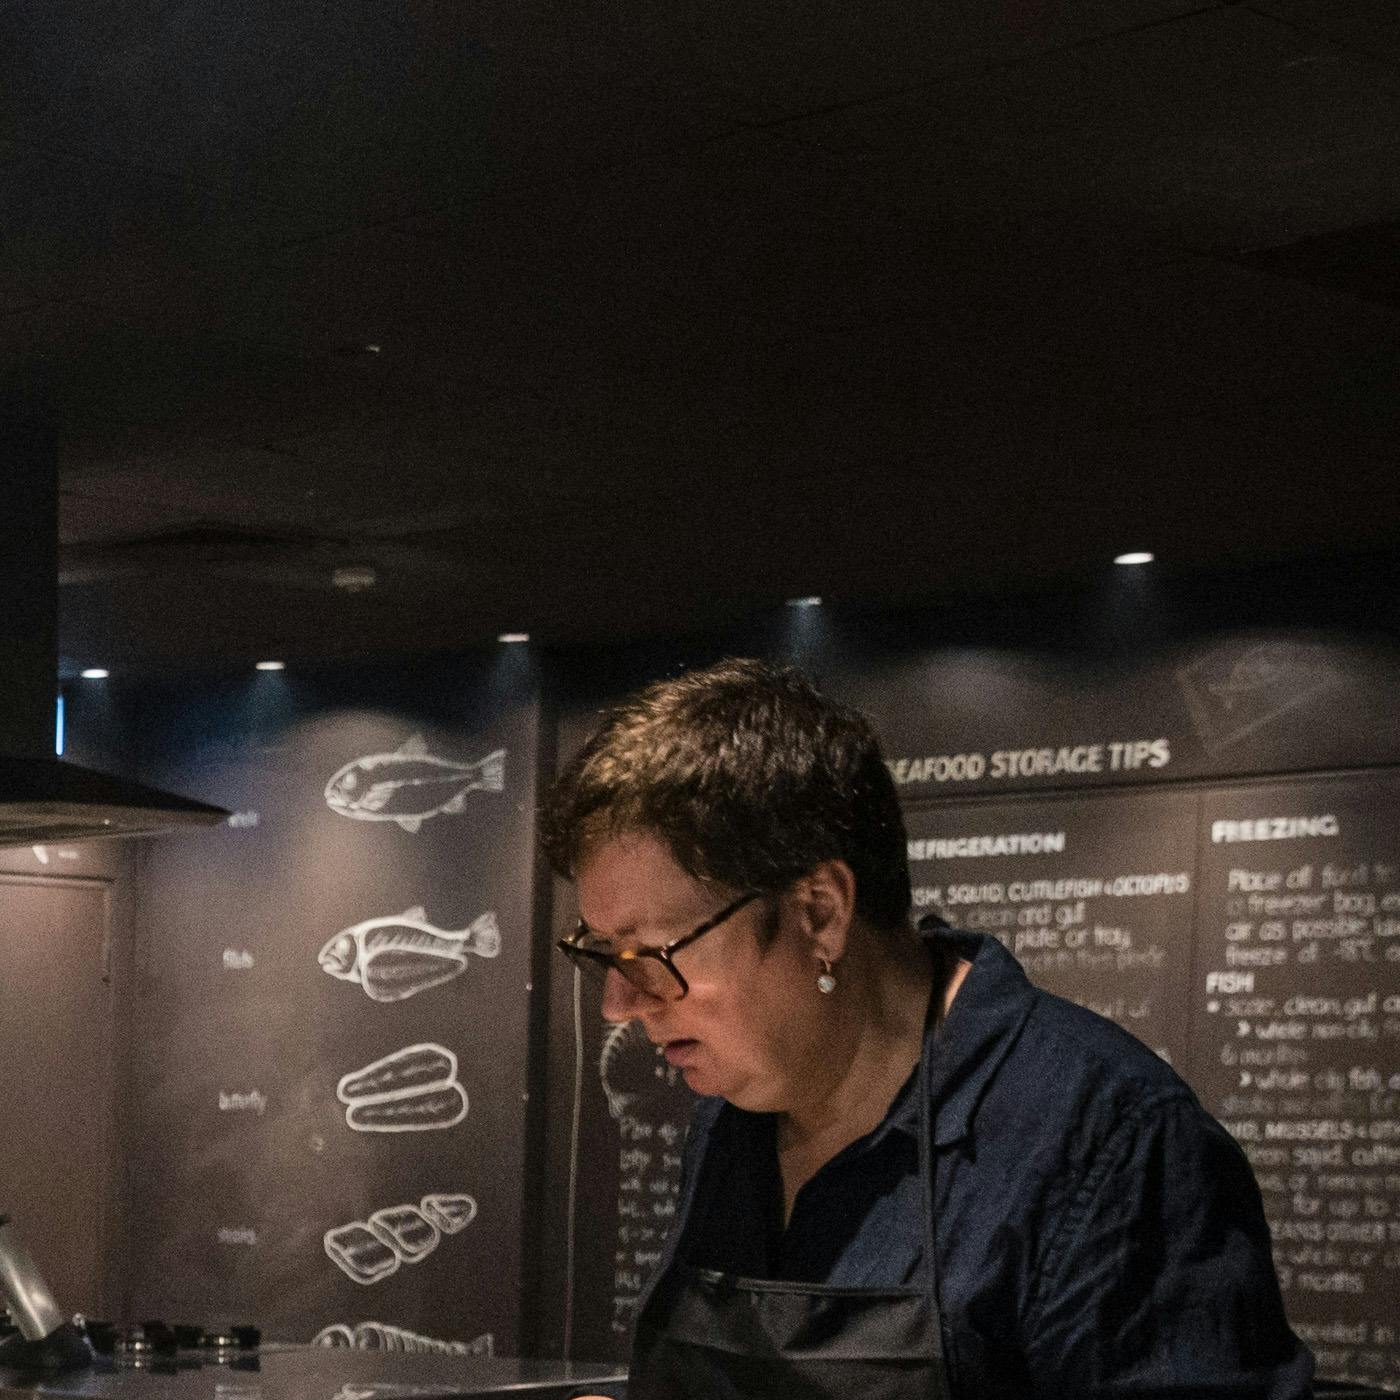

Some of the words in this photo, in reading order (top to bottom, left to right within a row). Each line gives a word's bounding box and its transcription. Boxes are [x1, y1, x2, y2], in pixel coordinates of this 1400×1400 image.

[990, 745, 1102, 780] STORAGE
[1107, 738, 1171, 772] TIPS
[1211, 814, 1339, 843] FREEZING
